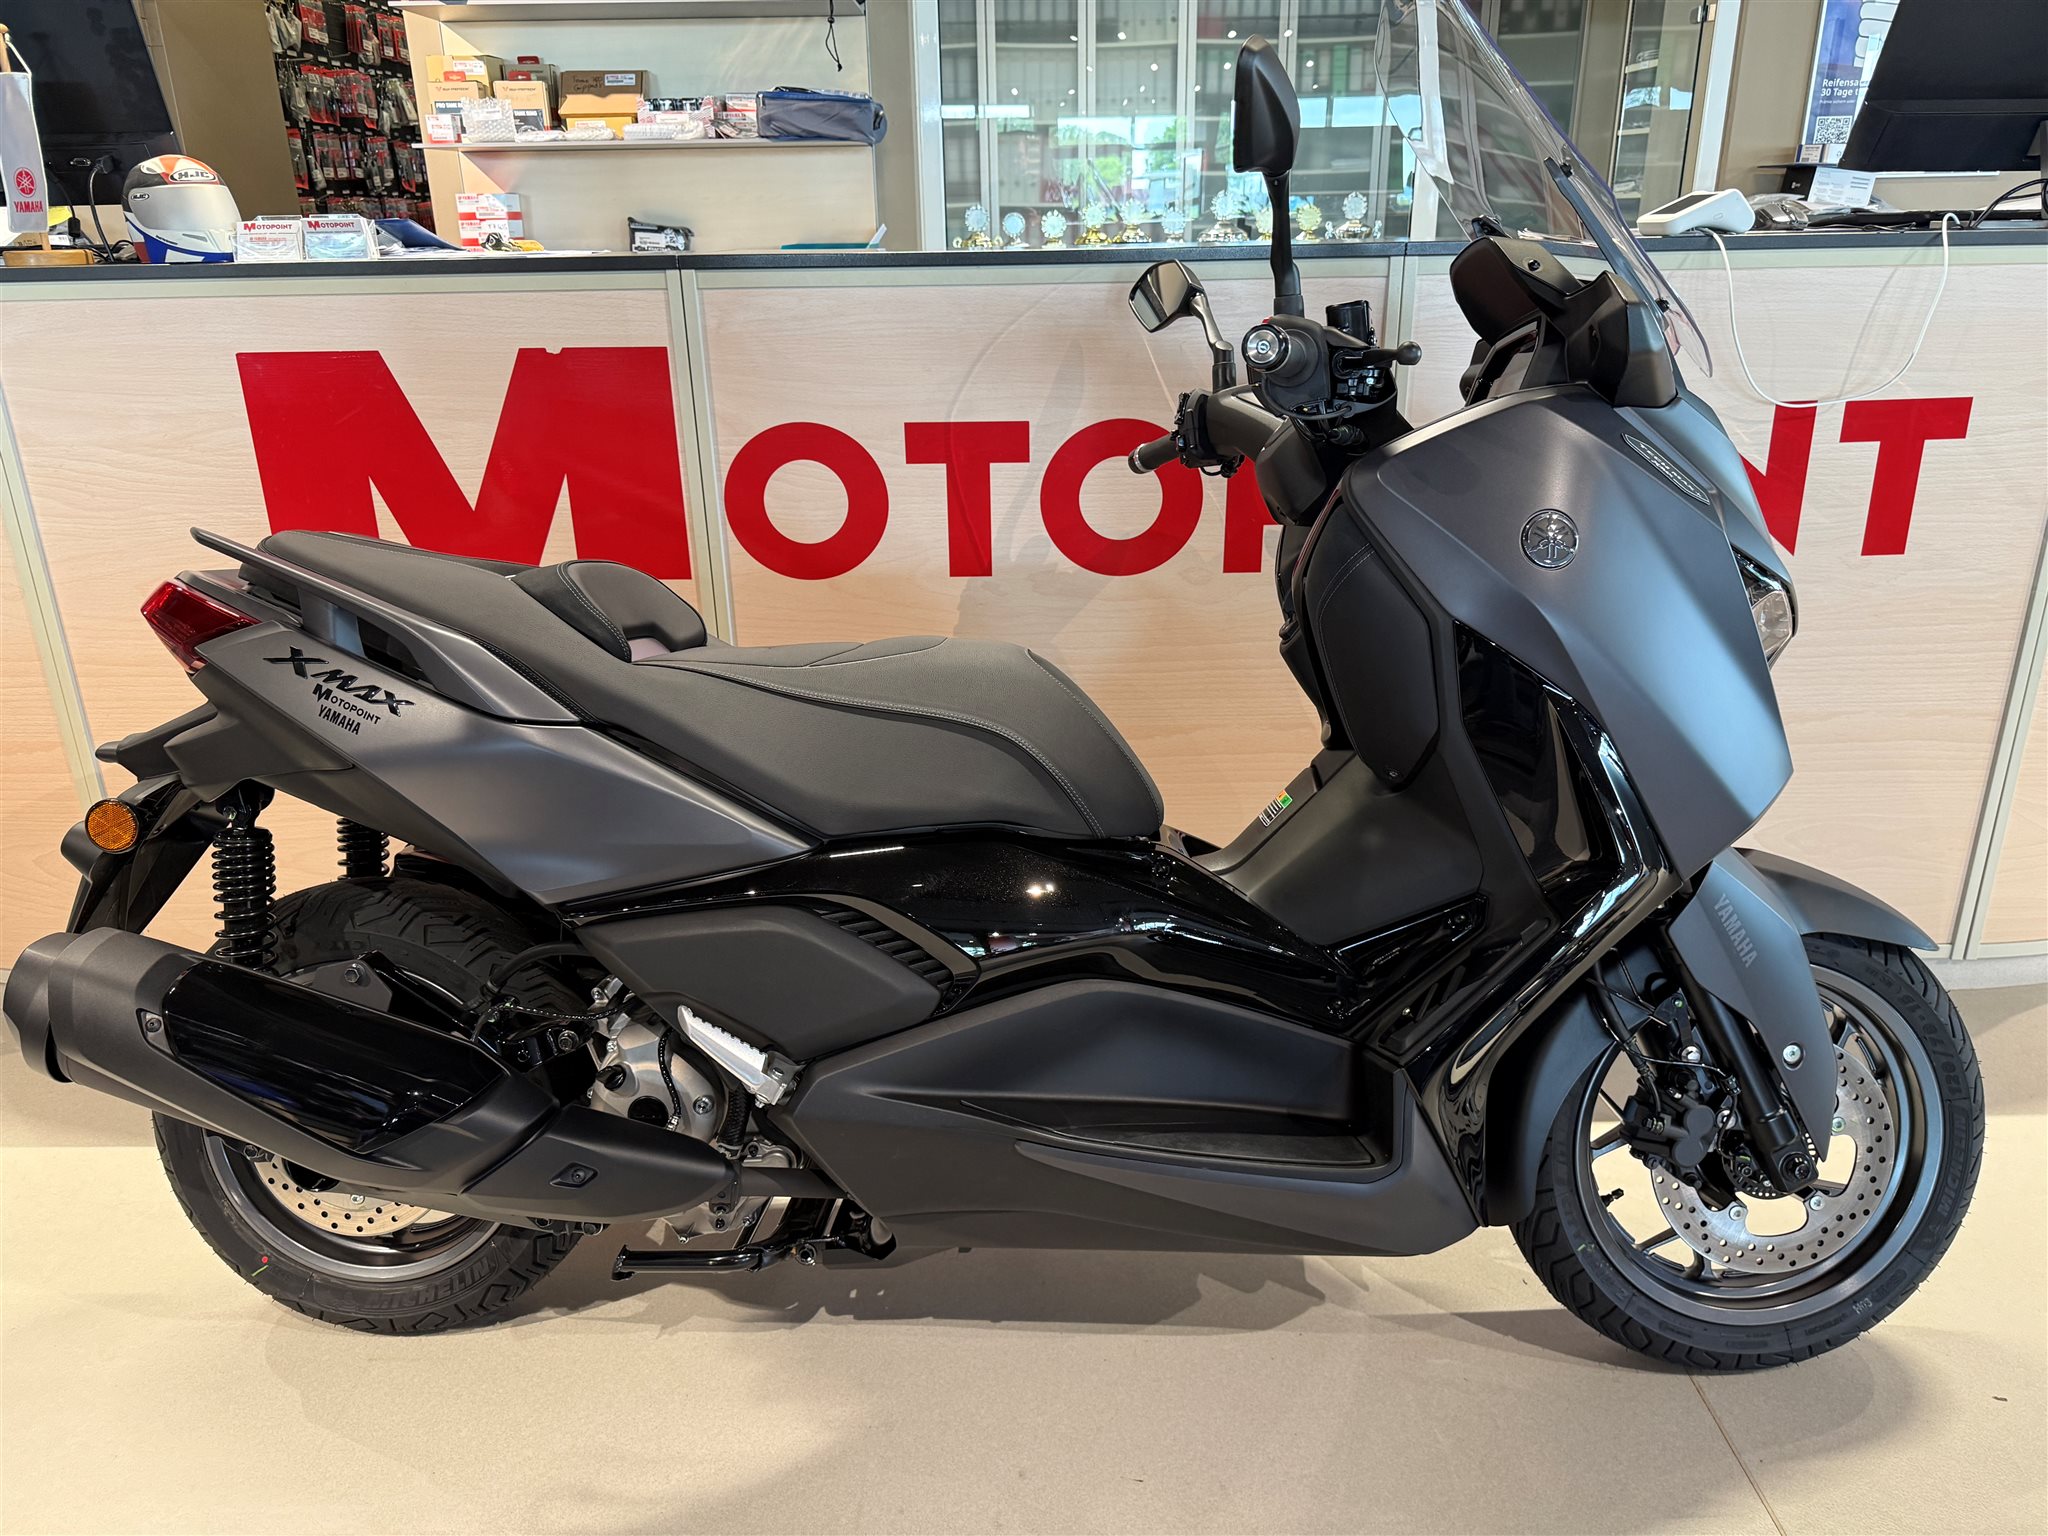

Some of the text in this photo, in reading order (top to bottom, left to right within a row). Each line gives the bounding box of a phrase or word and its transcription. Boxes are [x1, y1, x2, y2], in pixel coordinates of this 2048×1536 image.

[1820, 88, 1832, 97] 30
[1833, 87, 1853, 98] Tage
[177, 171, 210, 180] HJC
[13, 200, 44, 213] YAMAHA
[243, 222, 292, 232] MOTOPOINT
[307, 220, 355, 231] MOTOPOINT
[312, 683, 382, 725] MOTOPOINT
[318, 704, 362, 736] YAMAHA
[1713, 893, 1758, 969] YAMAHA
